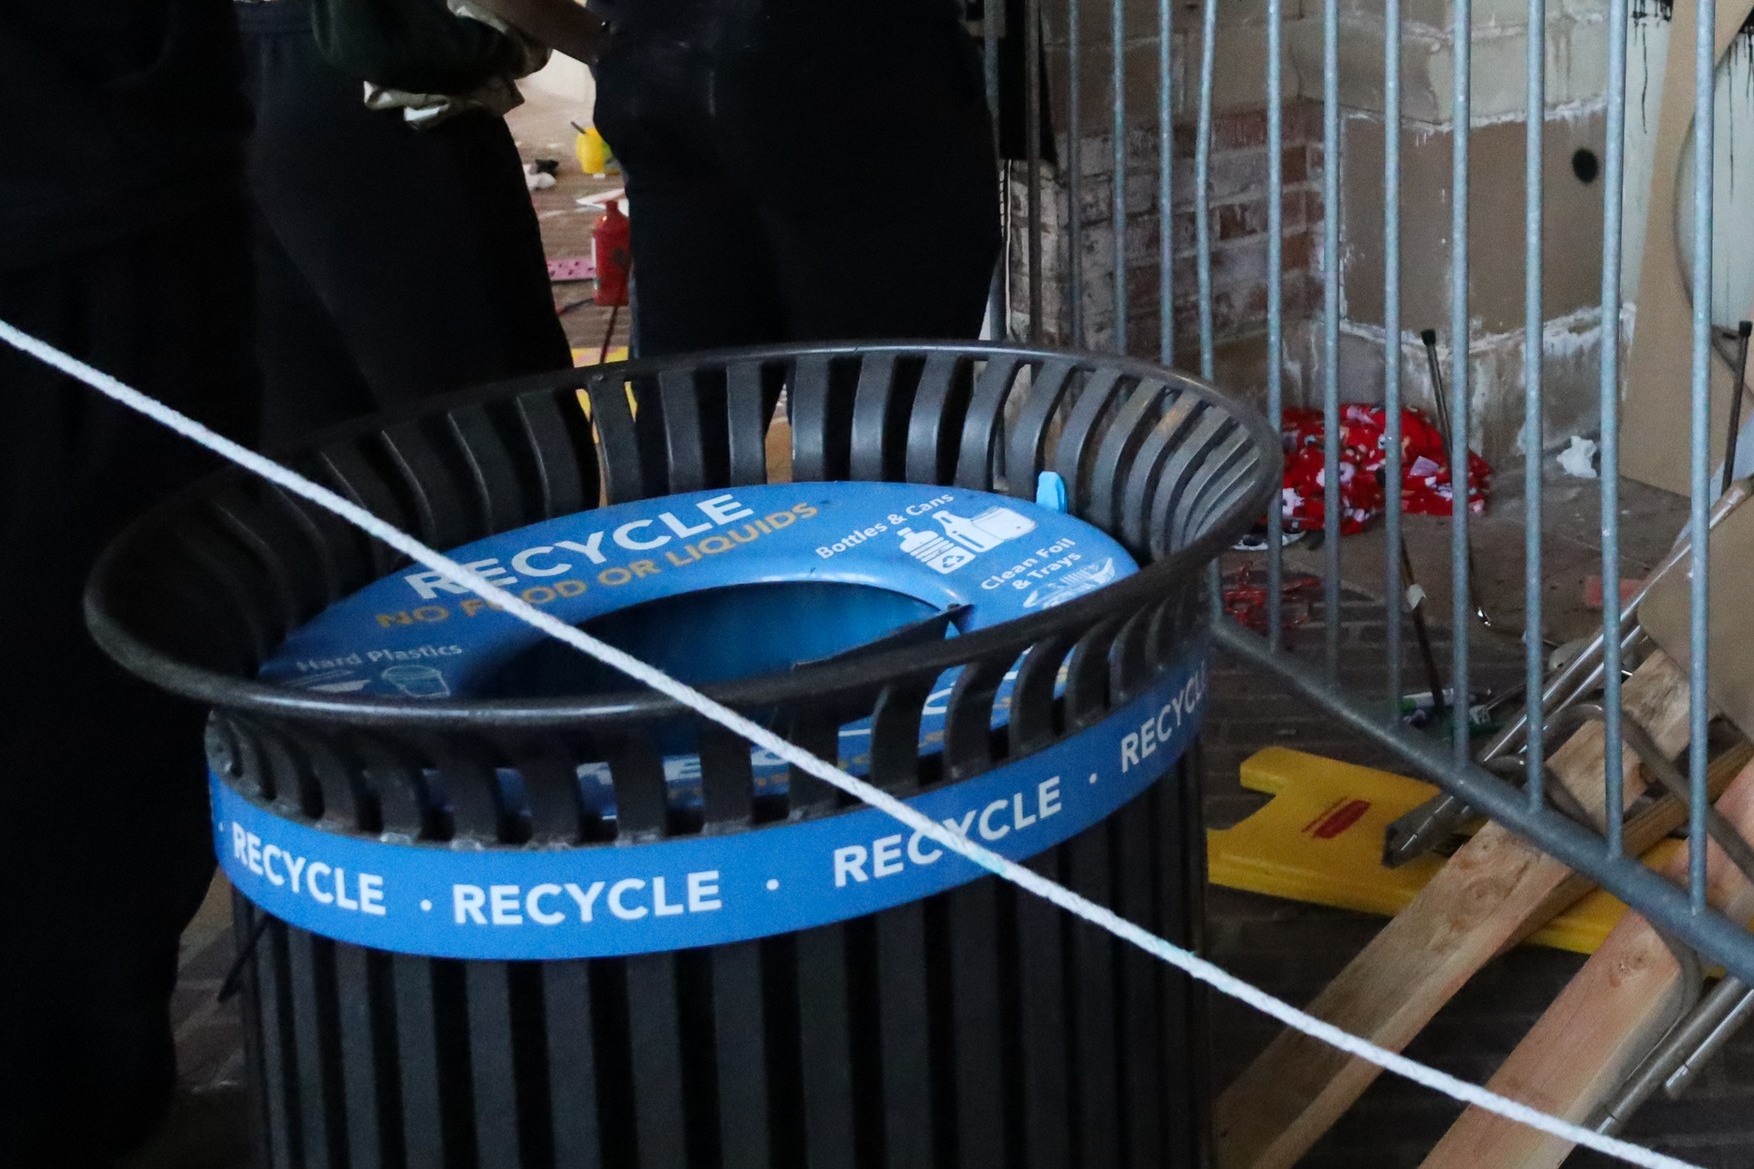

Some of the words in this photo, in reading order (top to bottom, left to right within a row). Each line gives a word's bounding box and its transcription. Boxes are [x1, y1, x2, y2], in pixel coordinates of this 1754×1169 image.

[404, 494, 755, 600] RECYCLE
[598, 558, 661, 586] OR
[665, 502, 819, 567] LIQUIDS
[815, 521, 889, 559] Bottles
[887, 513, 908, 526] &
[905, 493, 955, 516] Cans
[980, 555, 1039, 590] Clean
[1035, 537, 1077, 559] Foil
[1011, 577, 1031, 591] &
[1027, 551, 1082, 581] Trays
[296, 652, 363, 673] Hard
[366, 644, 463, 664] Plastics
[232, 820, 387, 917] RECYCLE
[453, 870, 723, 926] RECYCLE
[833, 776, 1062, 888] RECYCLE
